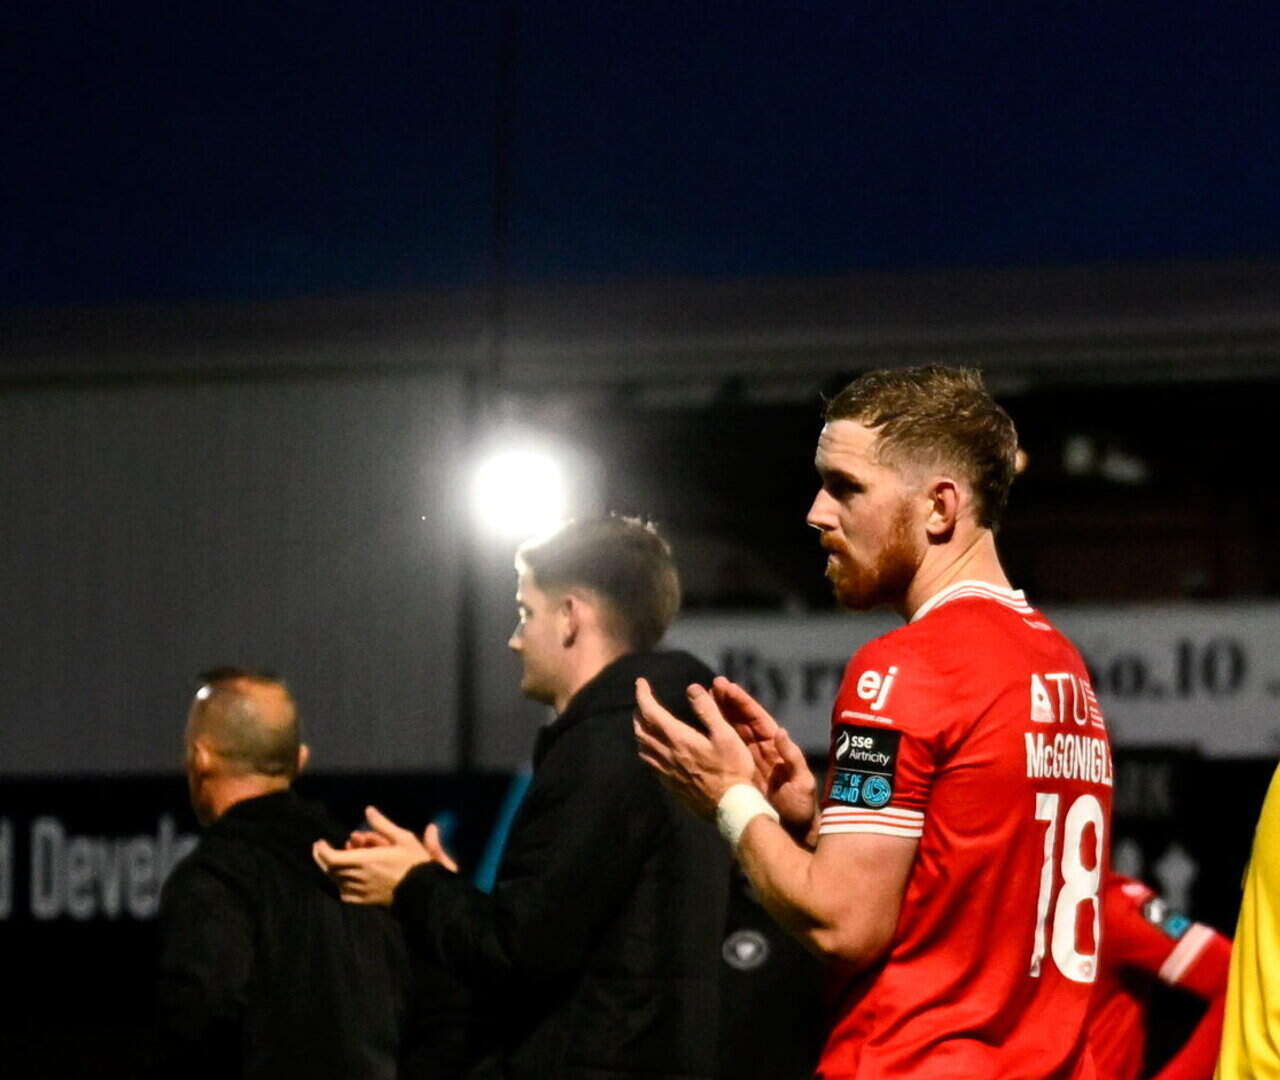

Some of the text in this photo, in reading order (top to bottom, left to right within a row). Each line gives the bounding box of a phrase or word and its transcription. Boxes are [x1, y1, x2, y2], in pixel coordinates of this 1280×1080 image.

[856, 665, 899, 711] ej
[849, 749, 891, 766] Airtricity
[850, 735, 874, 750] sse
[1027, 792, 1105, 984] 18
